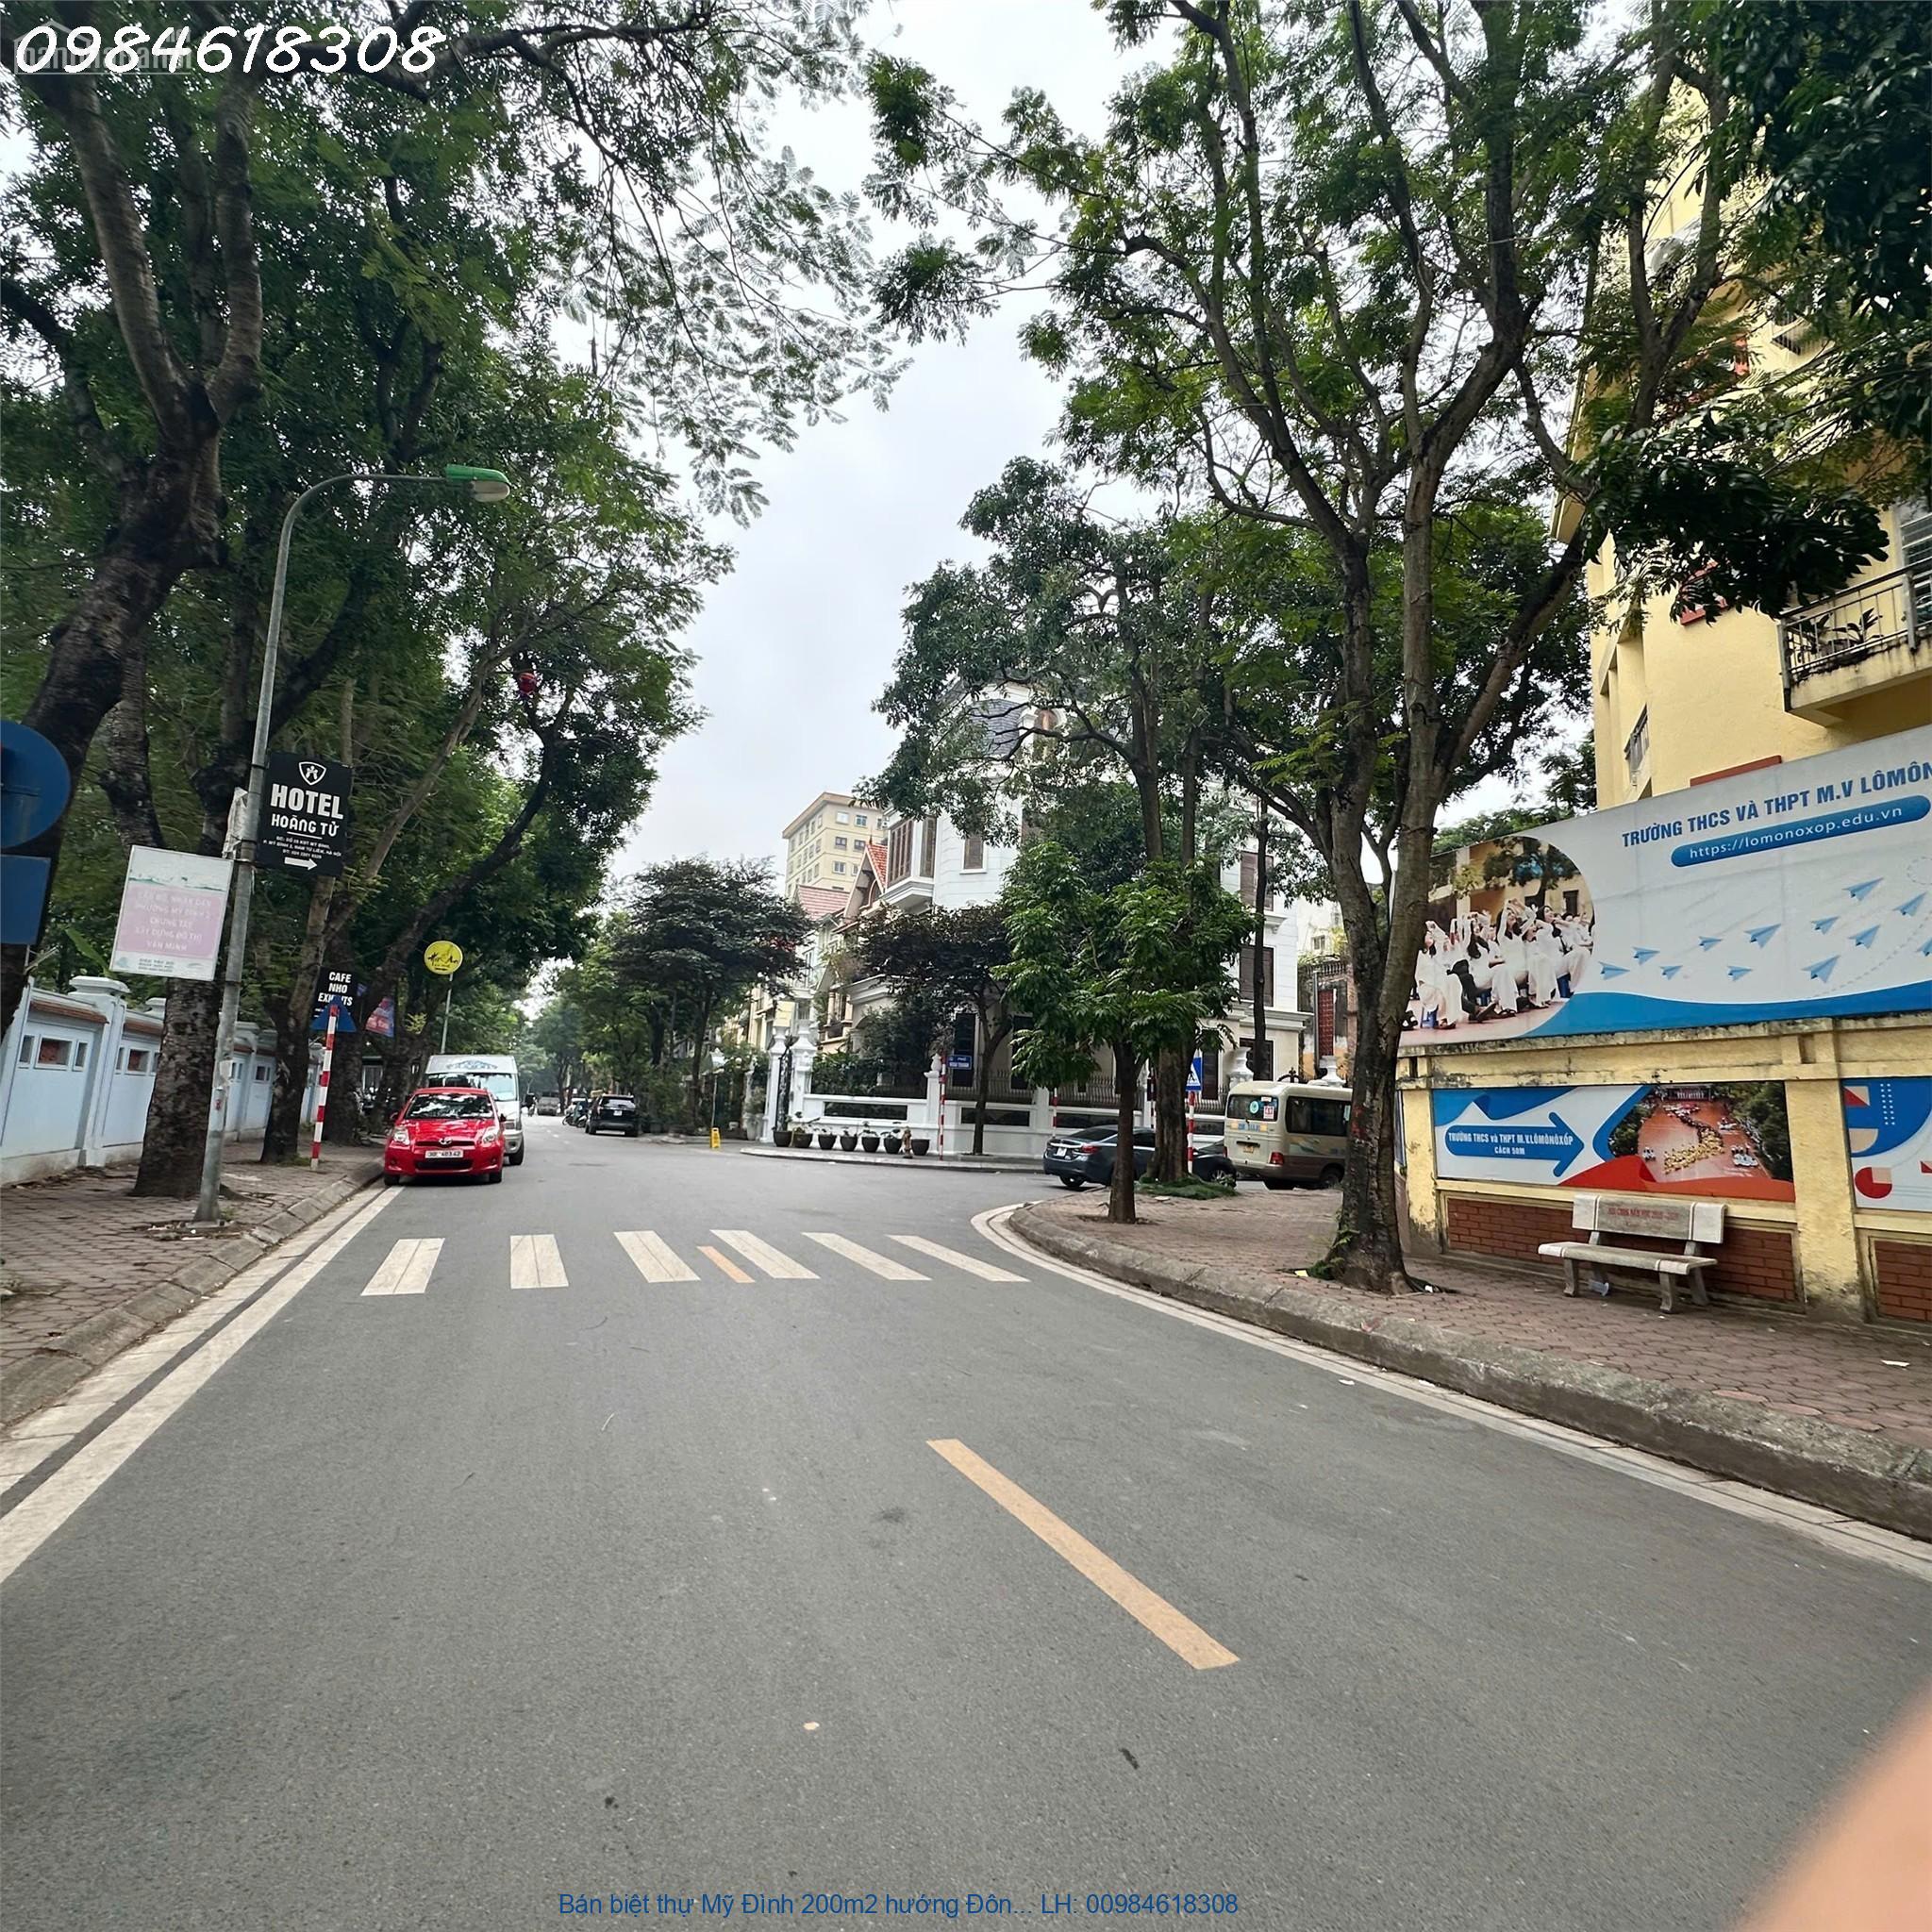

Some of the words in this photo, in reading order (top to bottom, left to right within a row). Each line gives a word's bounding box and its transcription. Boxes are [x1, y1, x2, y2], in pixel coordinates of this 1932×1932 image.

[270, 783, 343, 820] HOTEL
[1622, 821, 1683, 847] TRƯỜNG
[1688, 809, 1730, 833] THCS
[1736, 800, 1759, 822] VÀ
[1763, 790, 1810, 815] THPT
[1817, 780, 1854, 805] M.V
[320, 821, 340, 837] TỬ
[1690, 807, 1902, 859] https://lomonoxop.edu.vn
[328, 972, 352, 983] CAFE
[328, 983, 347, 993] NHO
[1474, 1133, 1489, 1142] THCS
[1499, 1134, 1515, 1143] THPT
